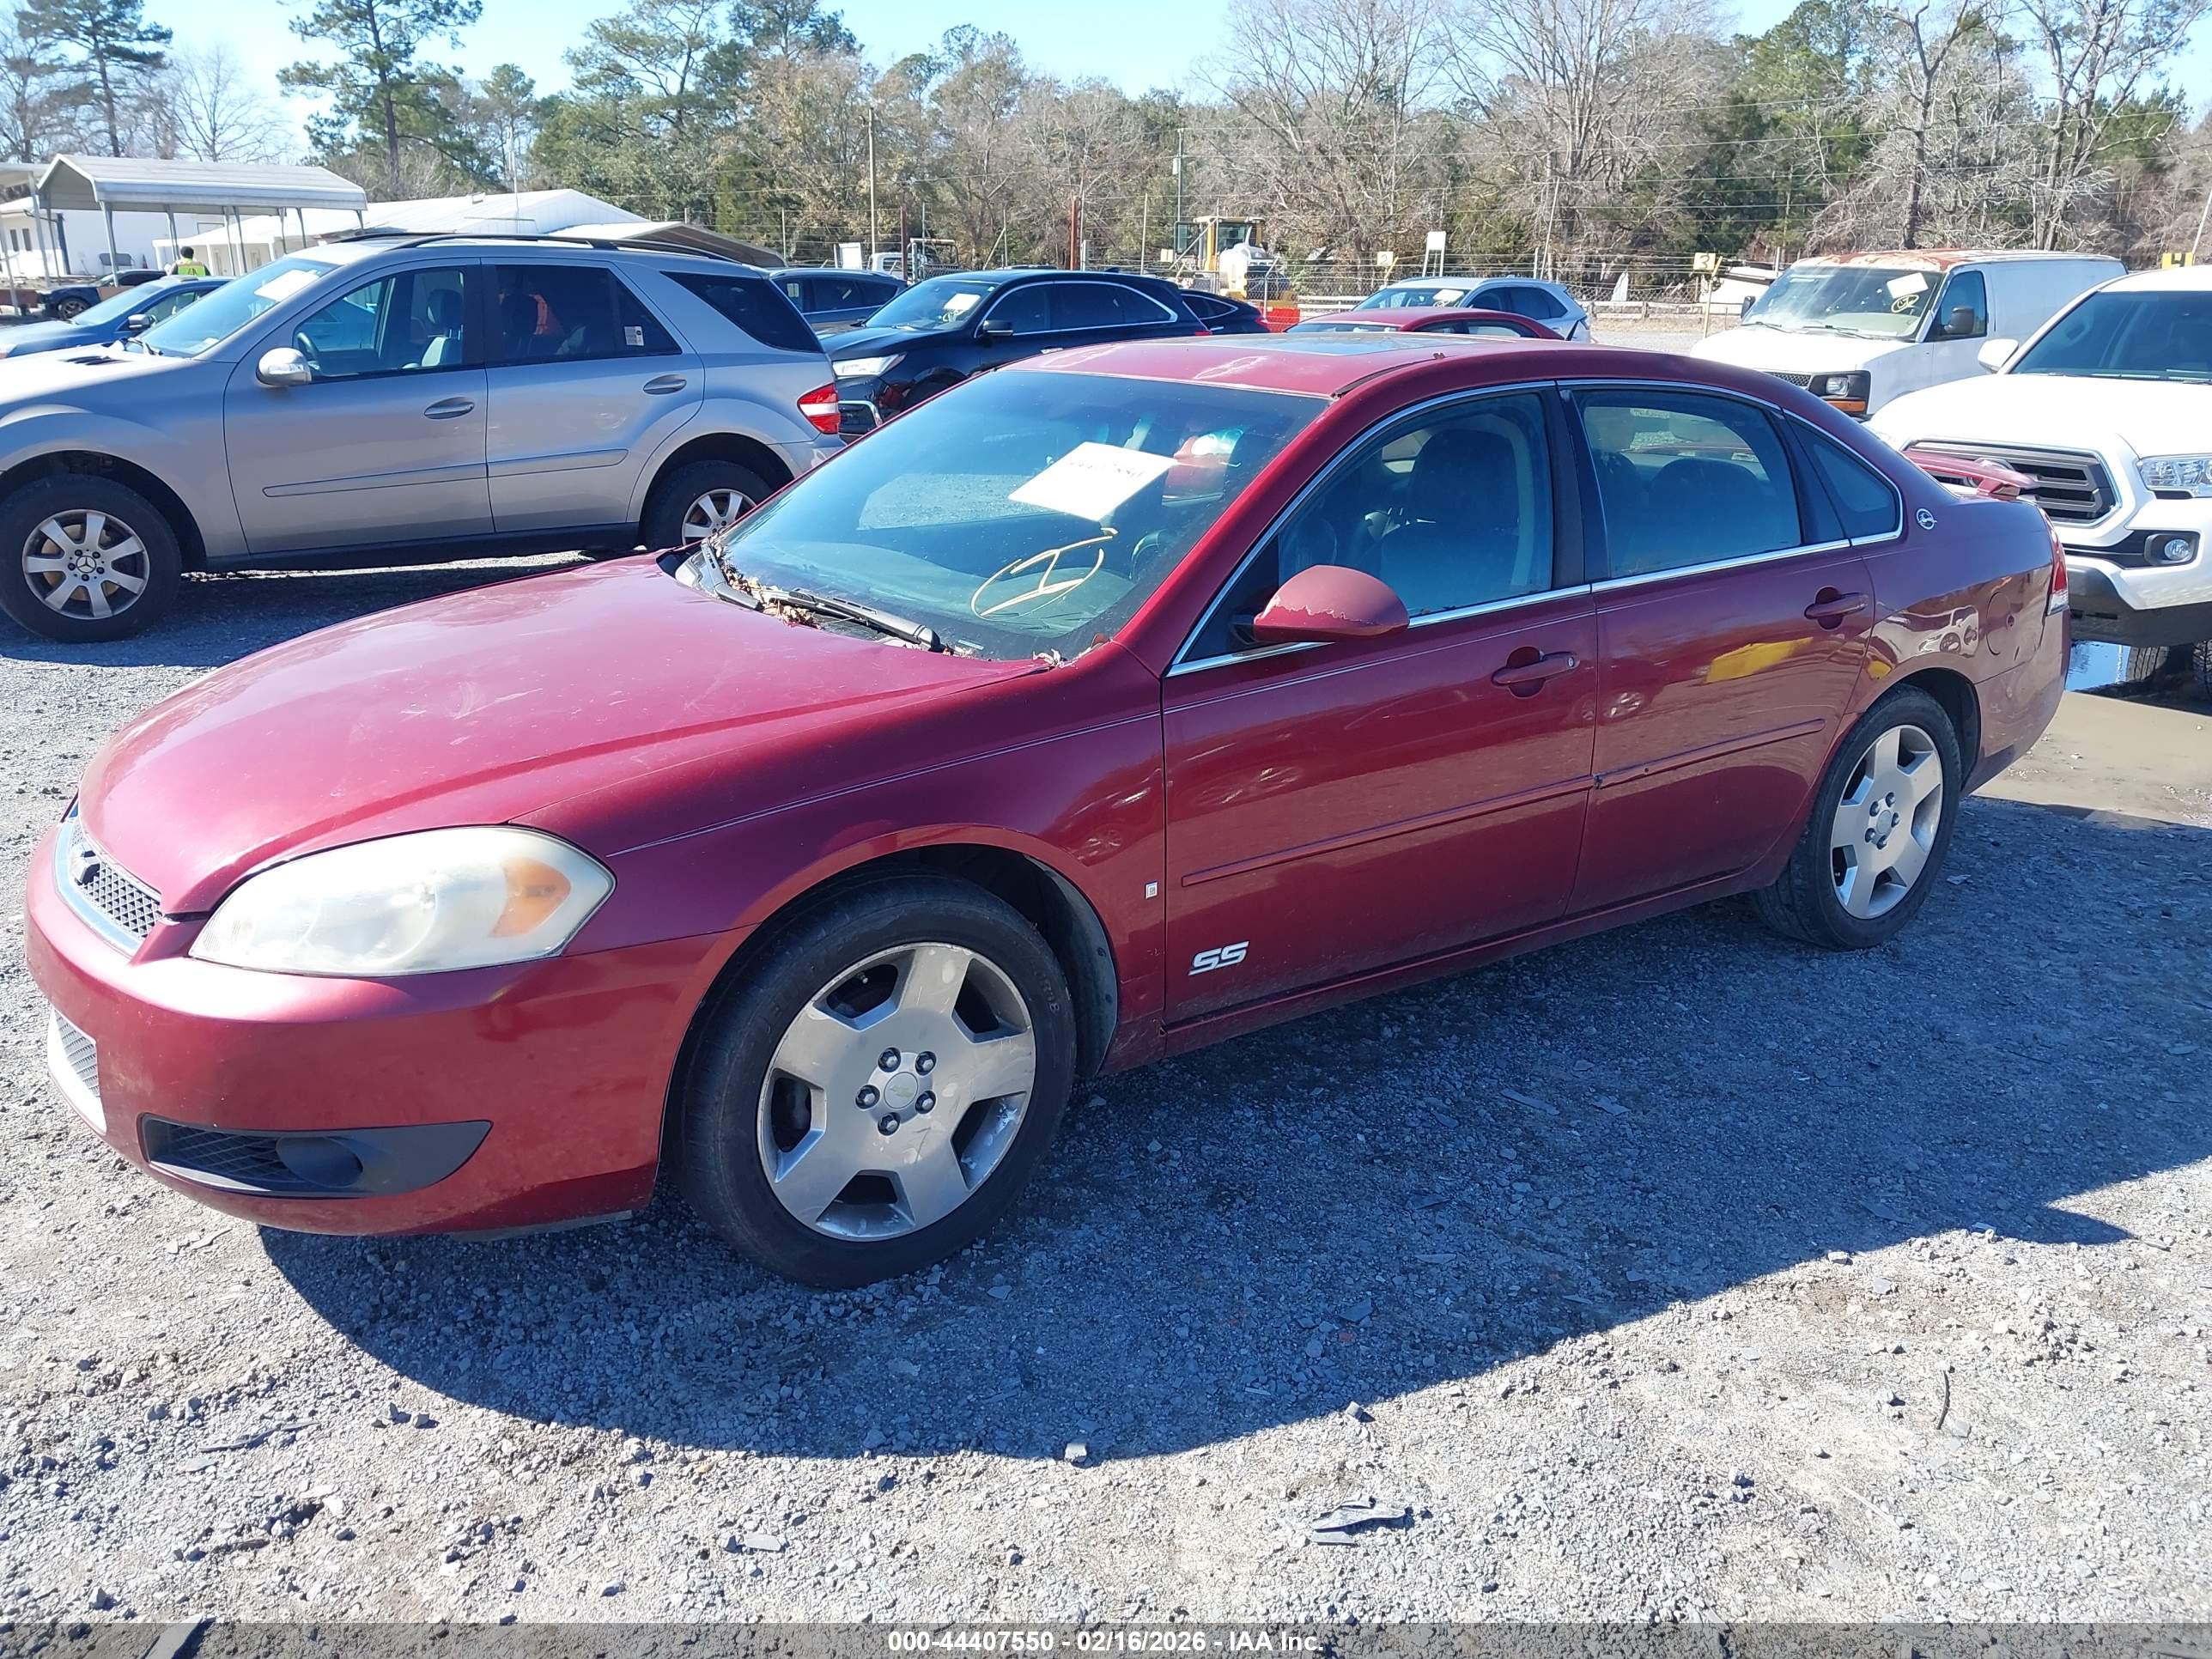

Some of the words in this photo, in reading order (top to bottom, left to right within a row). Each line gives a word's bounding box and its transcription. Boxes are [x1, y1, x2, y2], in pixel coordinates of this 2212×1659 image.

[1379, 253, 1389, 265] 2
[1698, 254, 1711, 270] 3
[2171, 253, 2186, 268] 4
[1187, 940, 1250, 976] SS
